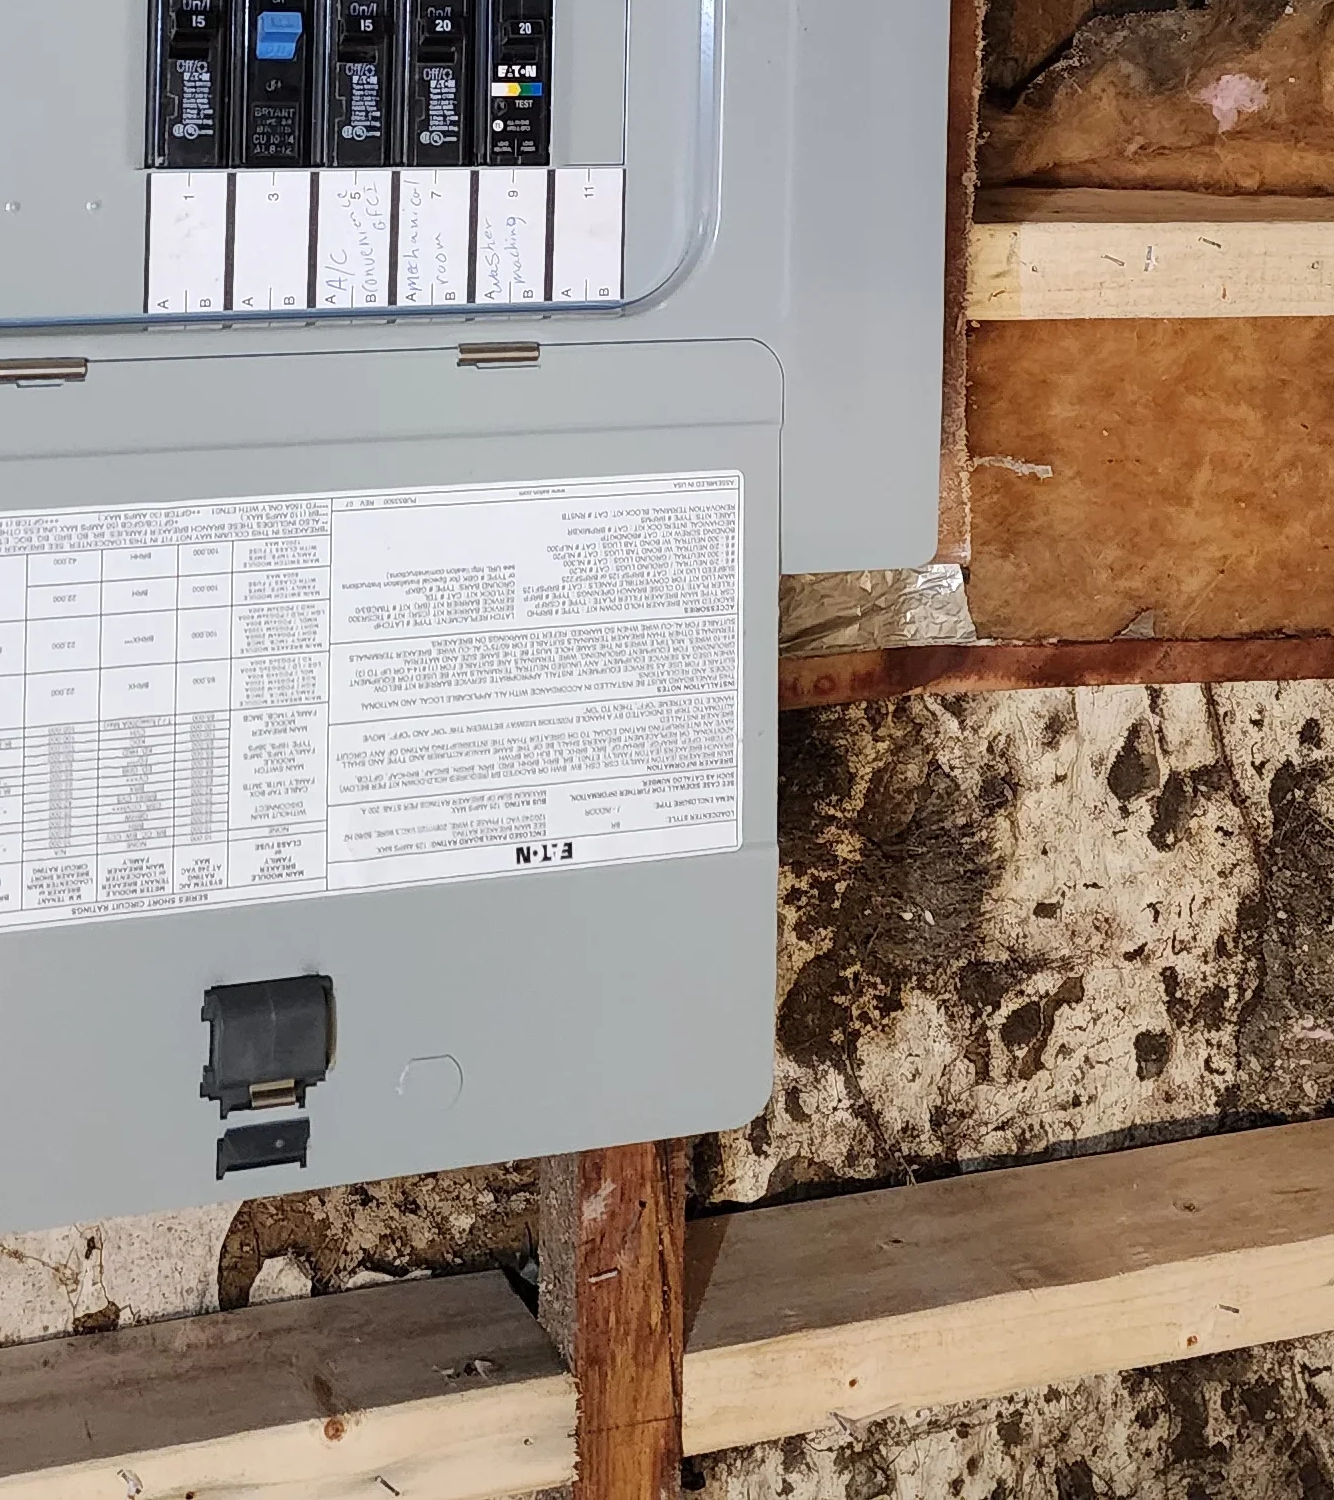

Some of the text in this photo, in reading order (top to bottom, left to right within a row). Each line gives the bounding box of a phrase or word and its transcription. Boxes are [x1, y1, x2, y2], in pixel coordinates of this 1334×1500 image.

[191, 15, 206, 27] 15
[360, 19, 373, 31] 15
[435, 20, 452, 32] 20
[518, 23, 532, 35] 20
[514, 100, 533, 108] TEST
[254, 107, 296, 118] BRYANT
[253, 134, 267, 144] CU
[267, 193, 280, 202] 3
[350, 191, 361, 201] 5
[430, 190, 442, 200] 7
[508, 189, 519, 198] 9
[583, 186, 594, 199] 11
[363, 181, 387, 231] GFCI
[433, 232, 449, 286] room
[405, 291, 418, 303] A
[445, 291, 456, 301] B
[485, 290, 496, 301] A
[523, 288, 534, 299] B
[561, 287, 573, 299] A
[599, 287, 610, 297] B
[157, 298, 169, 310] A
[200, 298, 212, 308] B
[242, 296, 255, 308] A
[284, 295, 295, 306] B
[325, 294, 337, 305] A
[365, 293, 377, 304] B
[695, 478, 734, 487] ASSEMBLED
[625, 502, 734, 516] RENOVATION TERMINAL BLOCK
[175, 533, 191, 541] NOT
[195, 532, 212, 540] MAY
[214, 530, 248, 539] COLUMN
[252, 528, 269, 536] THIS
[683, 603, 734, 613] ACCESSORIES
[490, 611, 514, 620] LATCH
[656, 679, 734, 692] INSTALLATION NOTES
[646, 756, 733, 771] BREAKER INFORMATION
[672, 774, 703, 783] CATALOG
[619, 786, 649, 797] FURTHER
[651, 785, 665, 793] FOR
[532, 797, 546, 805] BUS
[254, 839, 301, 850] CLASS FUSE
[263, 855, 291, 864] FAMILY
[259, 863, 295, 872] BREAKER
[251, 869, 303, 881] MAIN MODULE
[70, 892, 208, 914] SERIES SHORT CIRCUIT RATINGS
